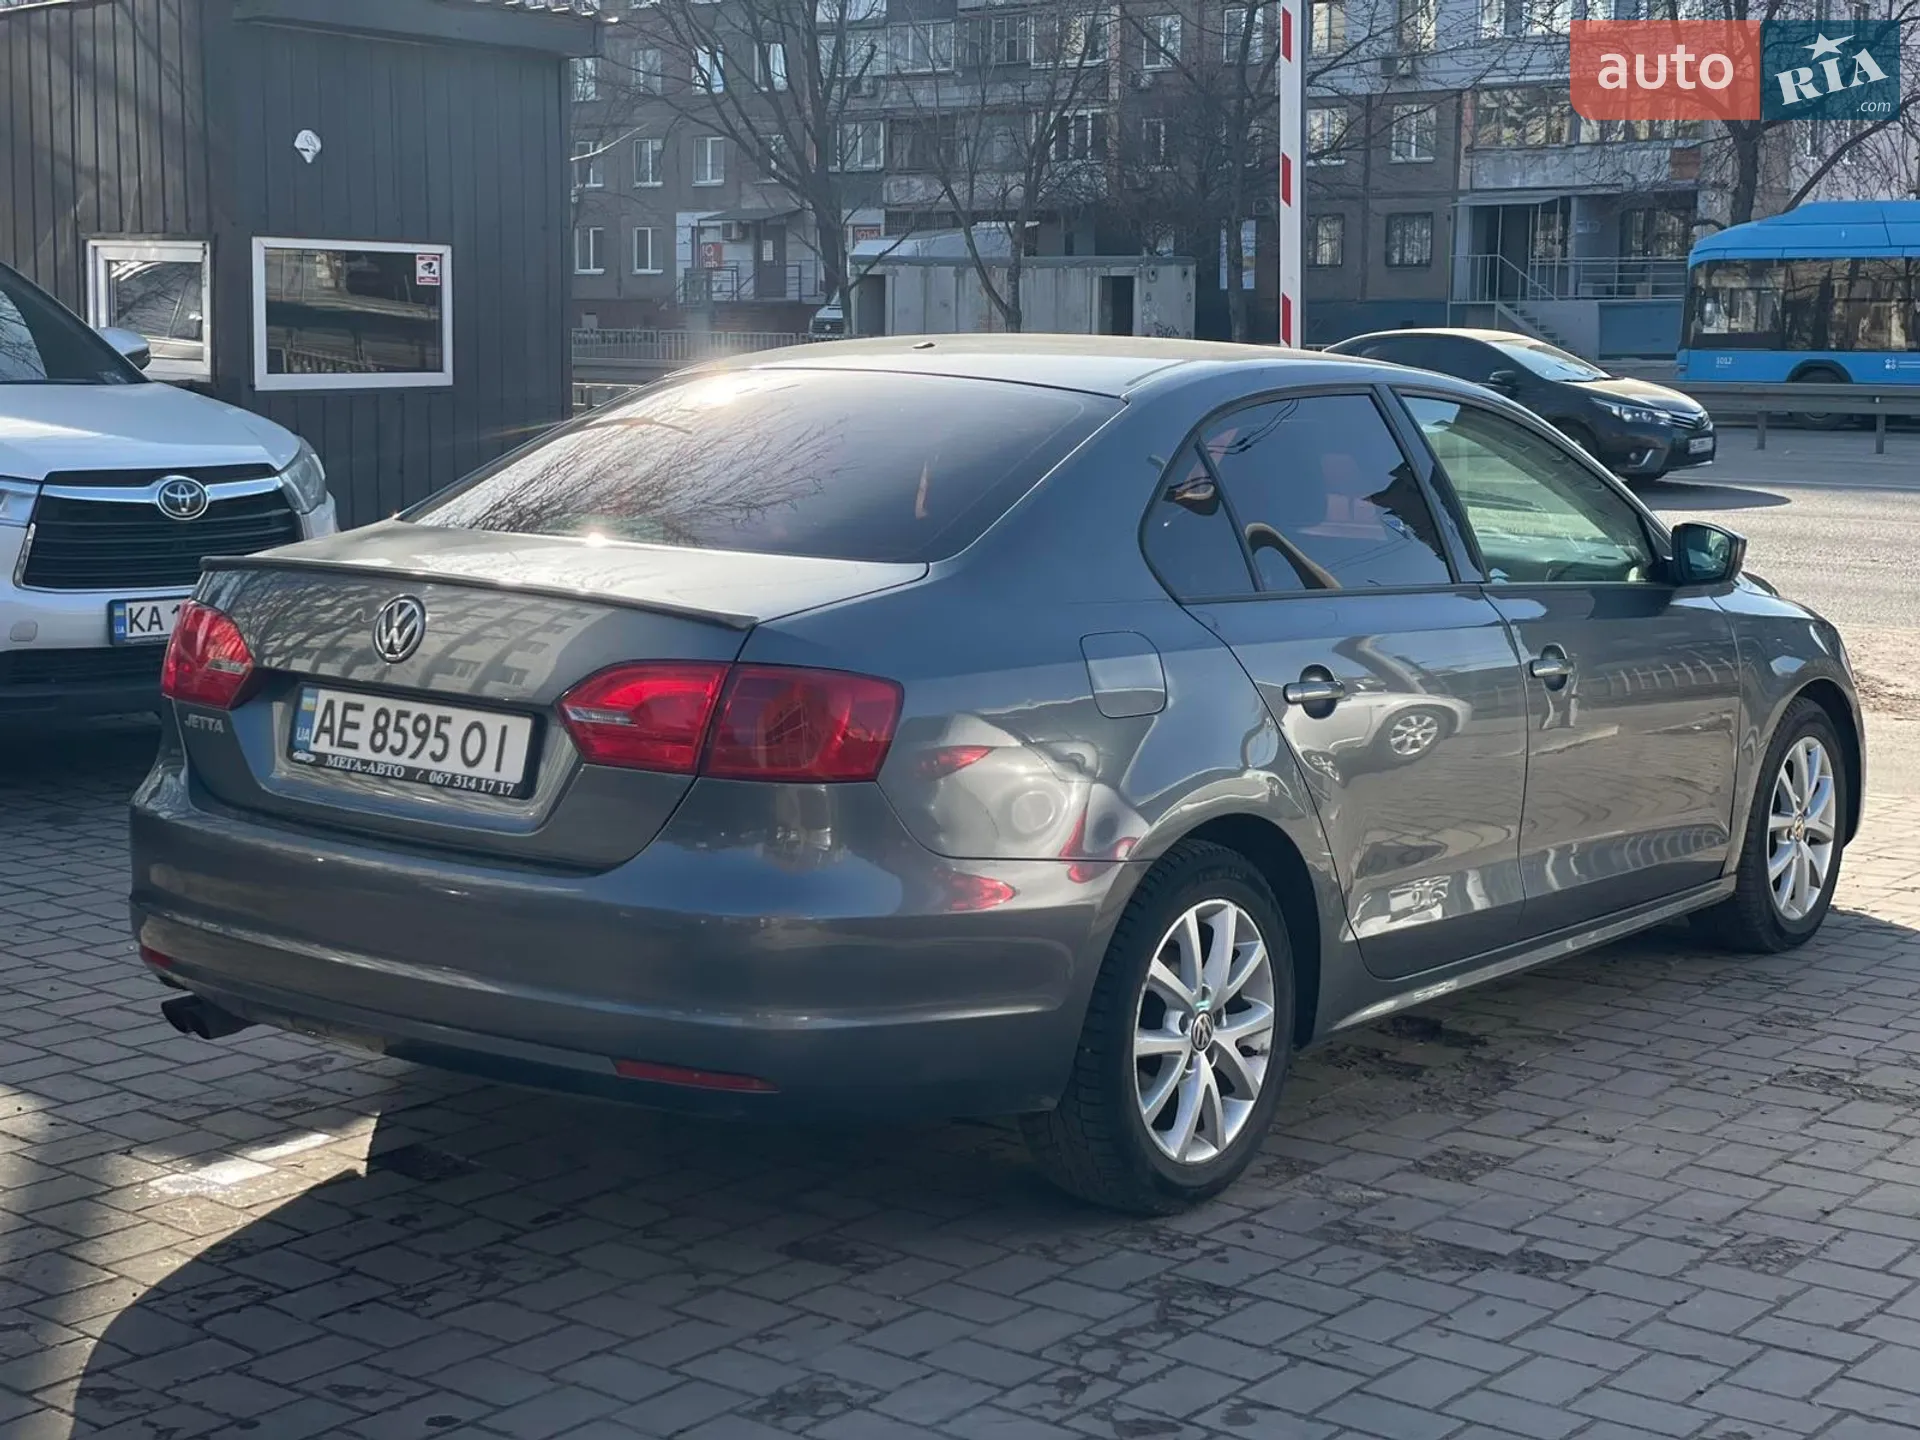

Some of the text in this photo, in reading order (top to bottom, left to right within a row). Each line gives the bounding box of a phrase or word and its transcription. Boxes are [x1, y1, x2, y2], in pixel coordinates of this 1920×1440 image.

[115, 625, 125, 634] UA
[128, 605, 164, 633] KA
[185, 713, 225, 733] JETTA
[296, 726, 311, 742] UA
[313, 699, 365, 750] AE
[369, 706, 452, 763] 8595
[325, 754, 405, 778] МЕГА-АВТО
[429, 770, 452, 786] 067
[453, 774, 476, 789] 314
[480, 778, 495, 793] 17
[499, 781, 515, 796] 17
